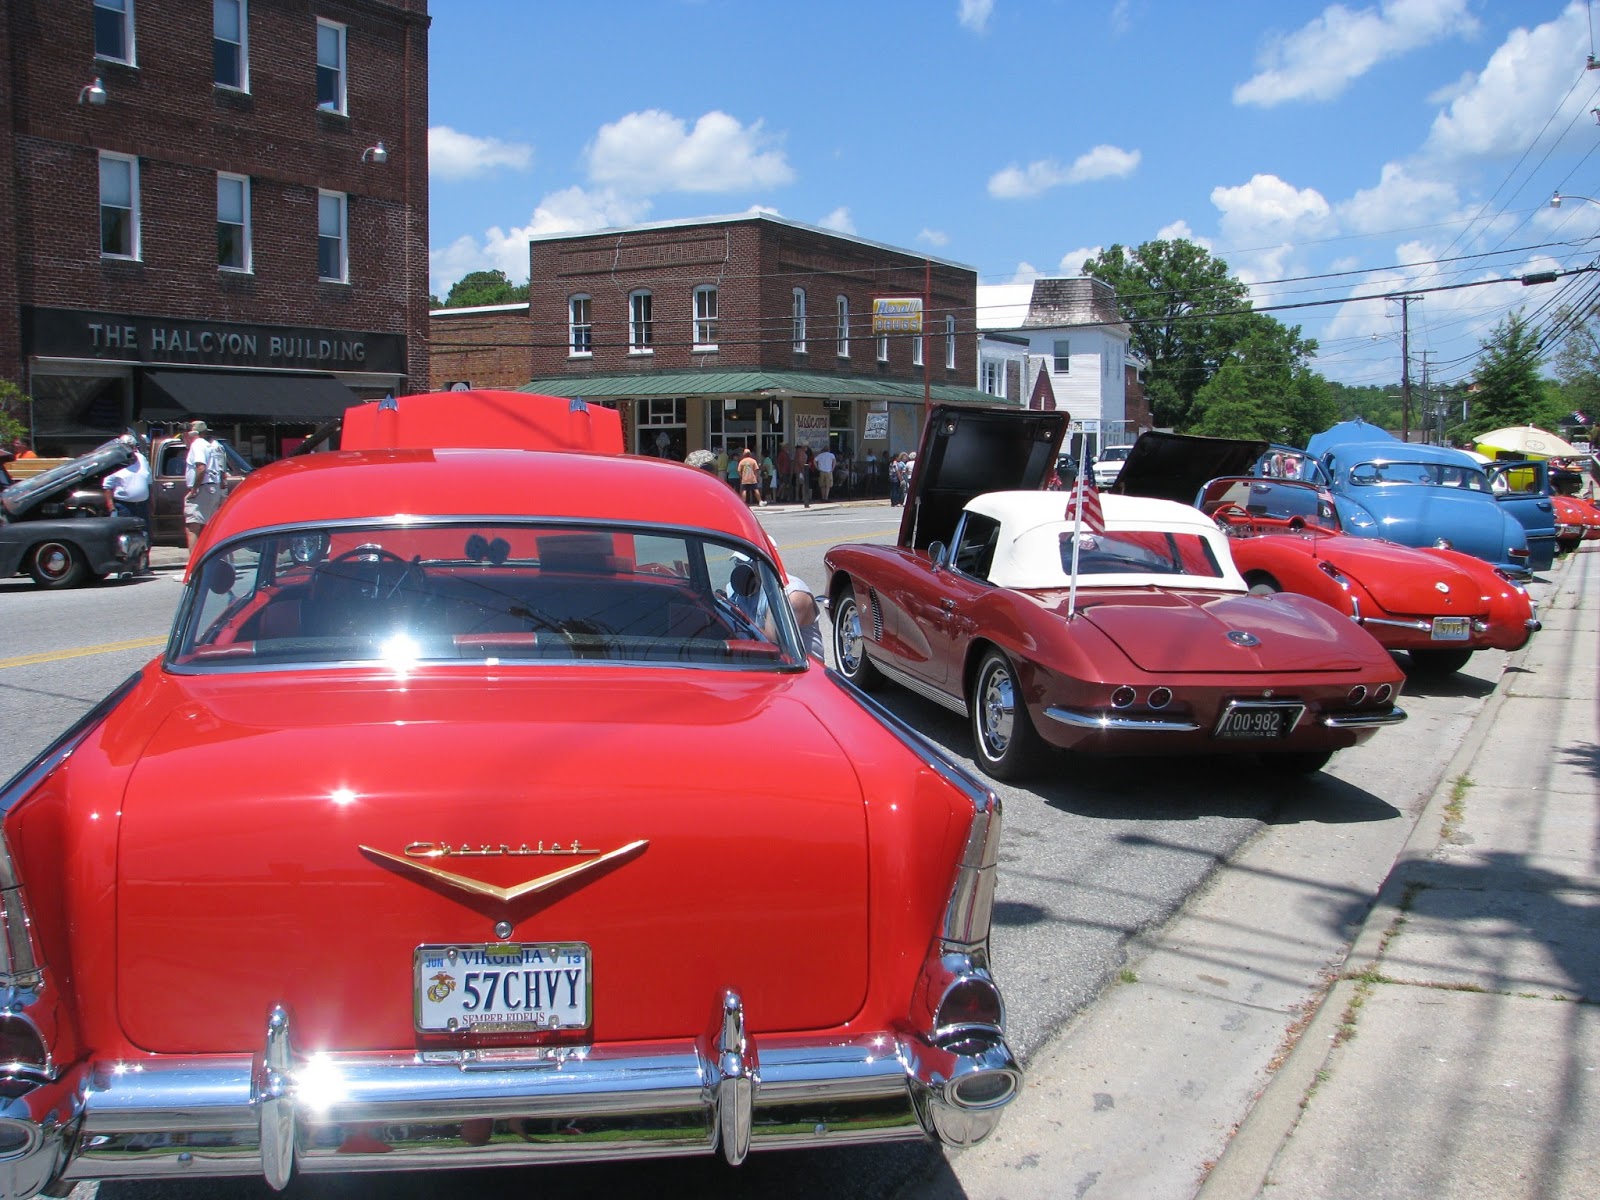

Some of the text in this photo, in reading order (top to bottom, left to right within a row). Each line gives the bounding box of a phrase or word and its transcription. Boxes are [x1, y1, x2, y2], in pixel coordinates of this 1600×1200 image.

[876, 300, 920, 313] Rexall
[876, 320, 919, 331] DRUGS
[88, 322, 367, 362] THE HALCYON BUILDING
[796, 415, 828, 429] Welcome
[404, 840, 600, 858] Chevrolet
[425, 957, 444, 968] JUN
[462, 949, 545, 966] VIRGINIA
[567, 955, 581, 964] 13
[463, 969, 582, 1011] 57CHVY
[462, 1012, 545, 1025] SEMPER FIDELIS
